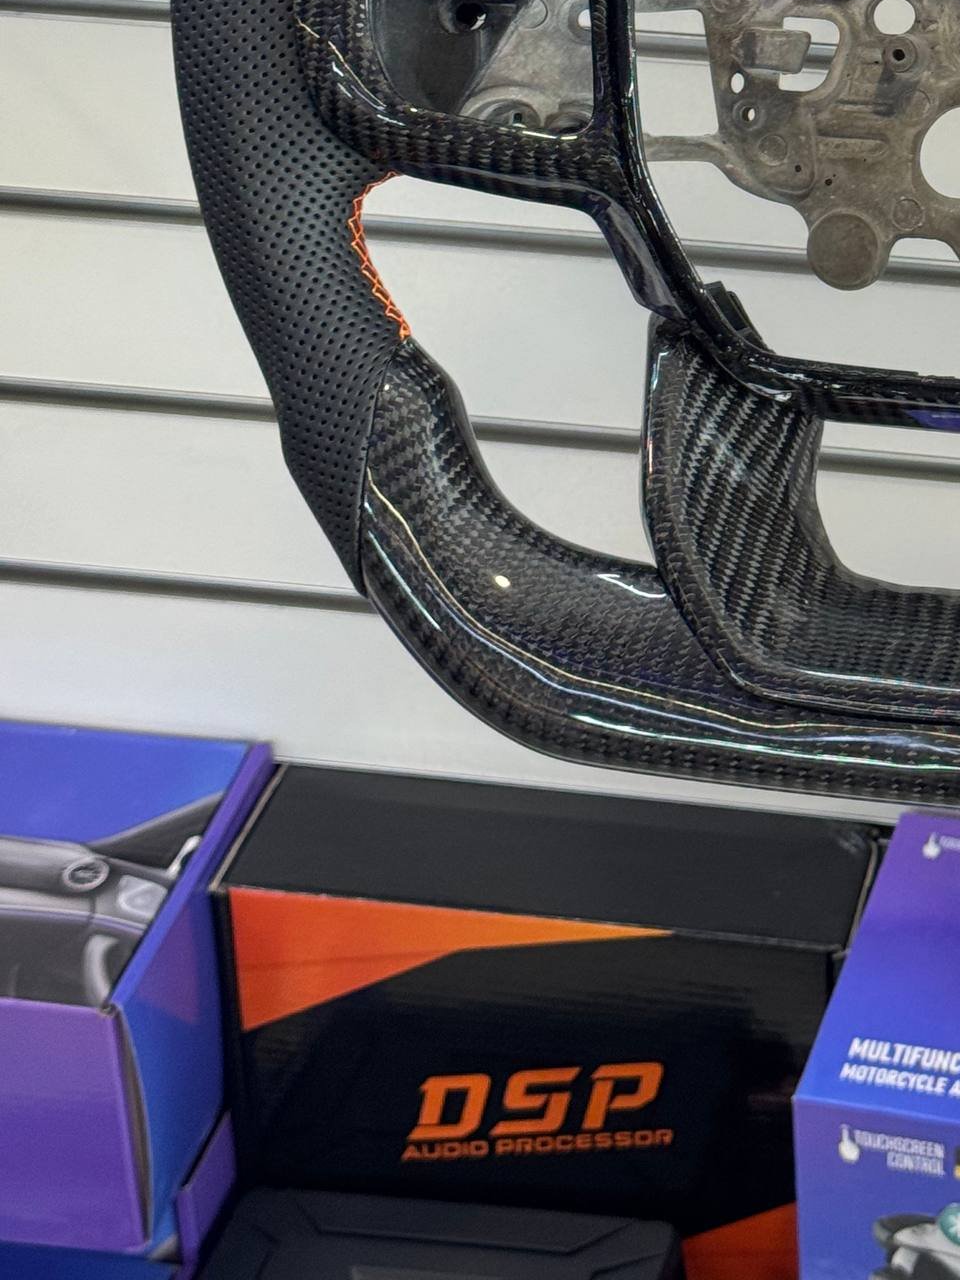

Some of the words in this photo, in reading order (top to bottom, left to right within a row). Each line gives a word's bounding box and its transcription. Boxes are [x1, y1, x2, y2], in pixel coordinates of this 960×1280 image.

[839, 1062, 949, 1094] MOTORCYCLE
[407, 1061, 664, 1140] DSP
[402, 1139, 489, 1161] AUDIO
[495, 1128, 674, 1156] PROCESSOR
